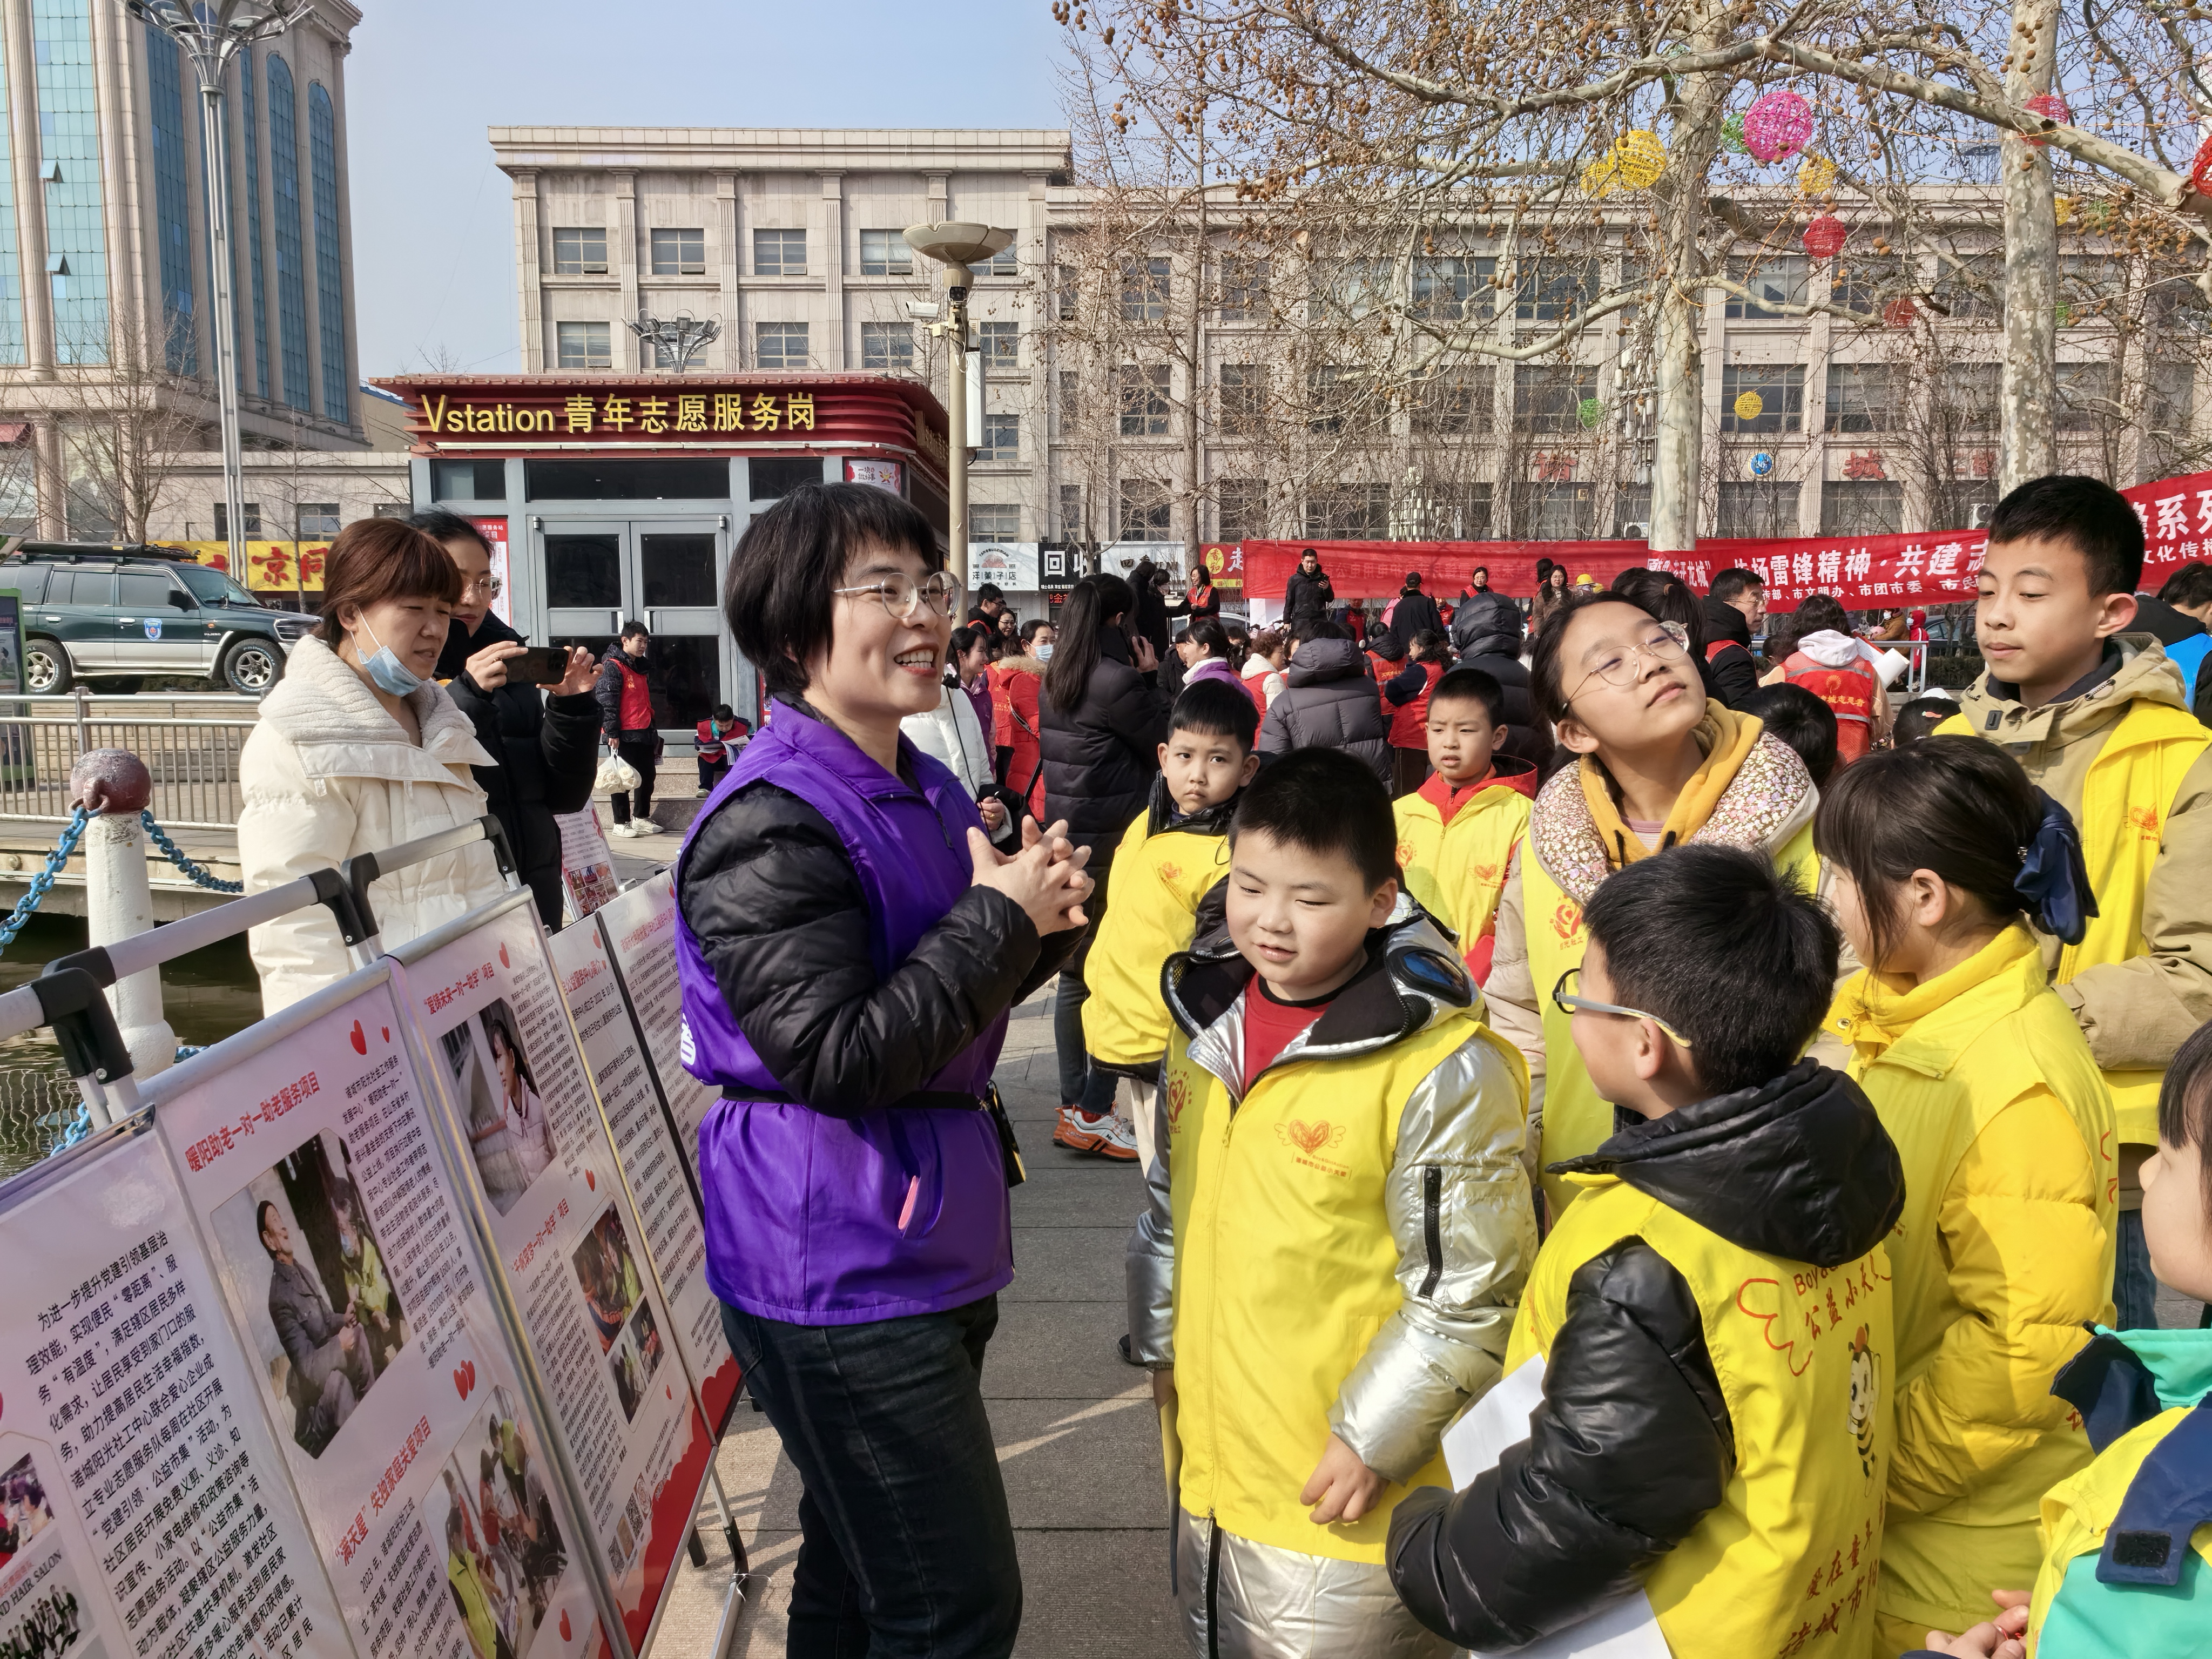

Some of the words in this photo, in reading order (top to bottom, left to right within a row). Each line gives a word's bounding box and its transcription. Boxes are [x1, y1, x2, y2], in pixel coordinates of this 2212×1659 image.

[421, 394, 552, 433] Vstation
[563, 392, 815, 434] 青年志愿服务岗
[185, 1071, 320, 1173] 暖阳助老一对一助老服务项目
[36, 1228, 168, 1333] 为进一步提升党建引领基层治
[36, 1278, 187, 1406] 务“有温度”，满足辖区居民多样
[47, 1303, 197, 1436] 化需求，让居民享受到家门口的服
[58, 1328, 205, 1464] 务，助力提高居民生活幸福指数，
[69, 1352, 215, 1493] 诸城阳光社工中心联合爱心企业成
[80, 1377, 224, 1521] 立专业志愿服务队每周在社区开展
[102, 1425, 241, 1576] 社区居民开展免费义剪、义诊、知
[335, 1414, 431, 1567] “满天星”失独家庭关爱项目
[10, 1577, 35, 1607] HAIR
[33, 1548, 62, 1583] SALON
[113, 1449, 251, 1604] 识宣传、小家电维修和政策咨询等
[124, 1473, 260, 1633] 志愿服务活动。以“公益市集”活
[188, 1545, 286, 1659] 更多暖心服务送到居民家
